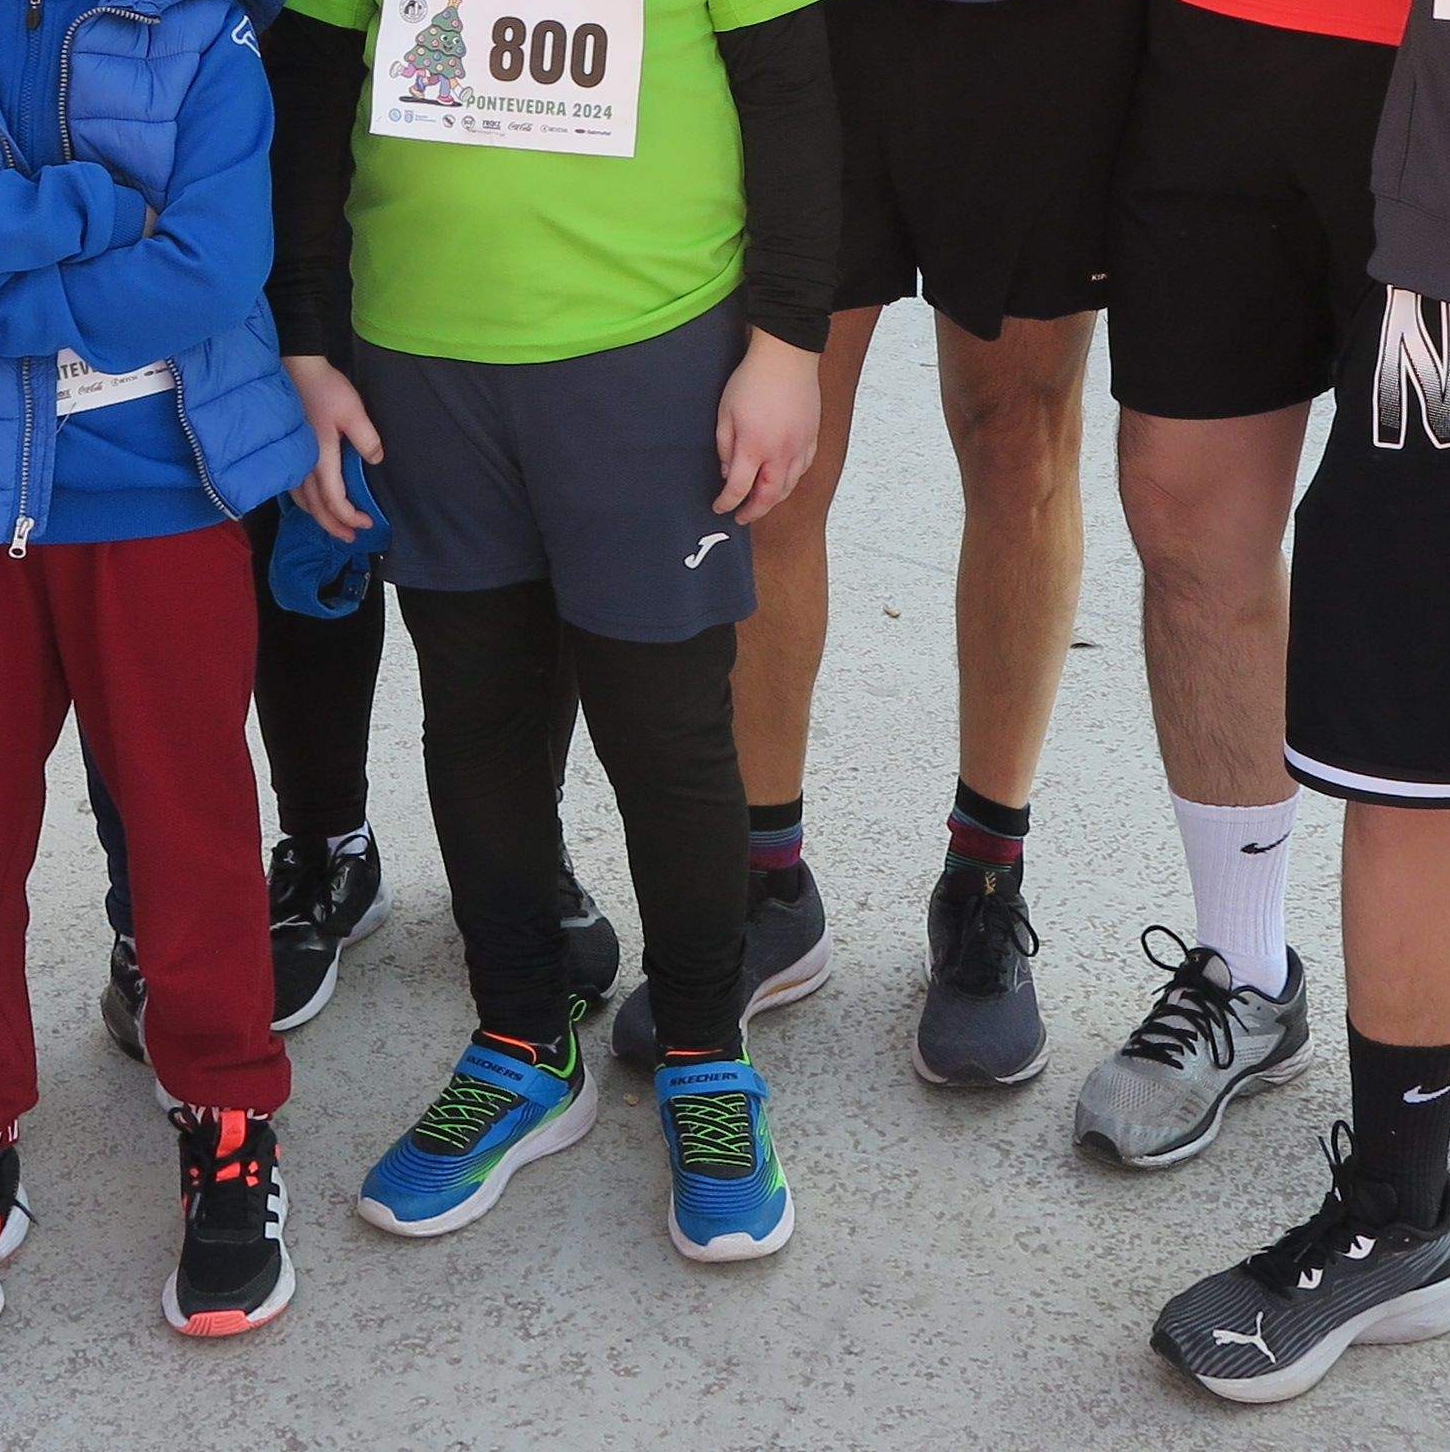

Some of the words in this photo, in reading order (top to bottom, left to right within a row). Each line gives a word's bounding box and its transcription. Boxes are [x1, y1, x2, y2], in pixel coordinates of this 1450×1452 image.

[489, 15, 608, 88] 800
[466, 95, 566, 116] PONTEVEDRA
[572, 103, 613, 119] 2024
[57, 360, 99, 382] TEV
[670, 1071, 738, 1087] SKECHERS
